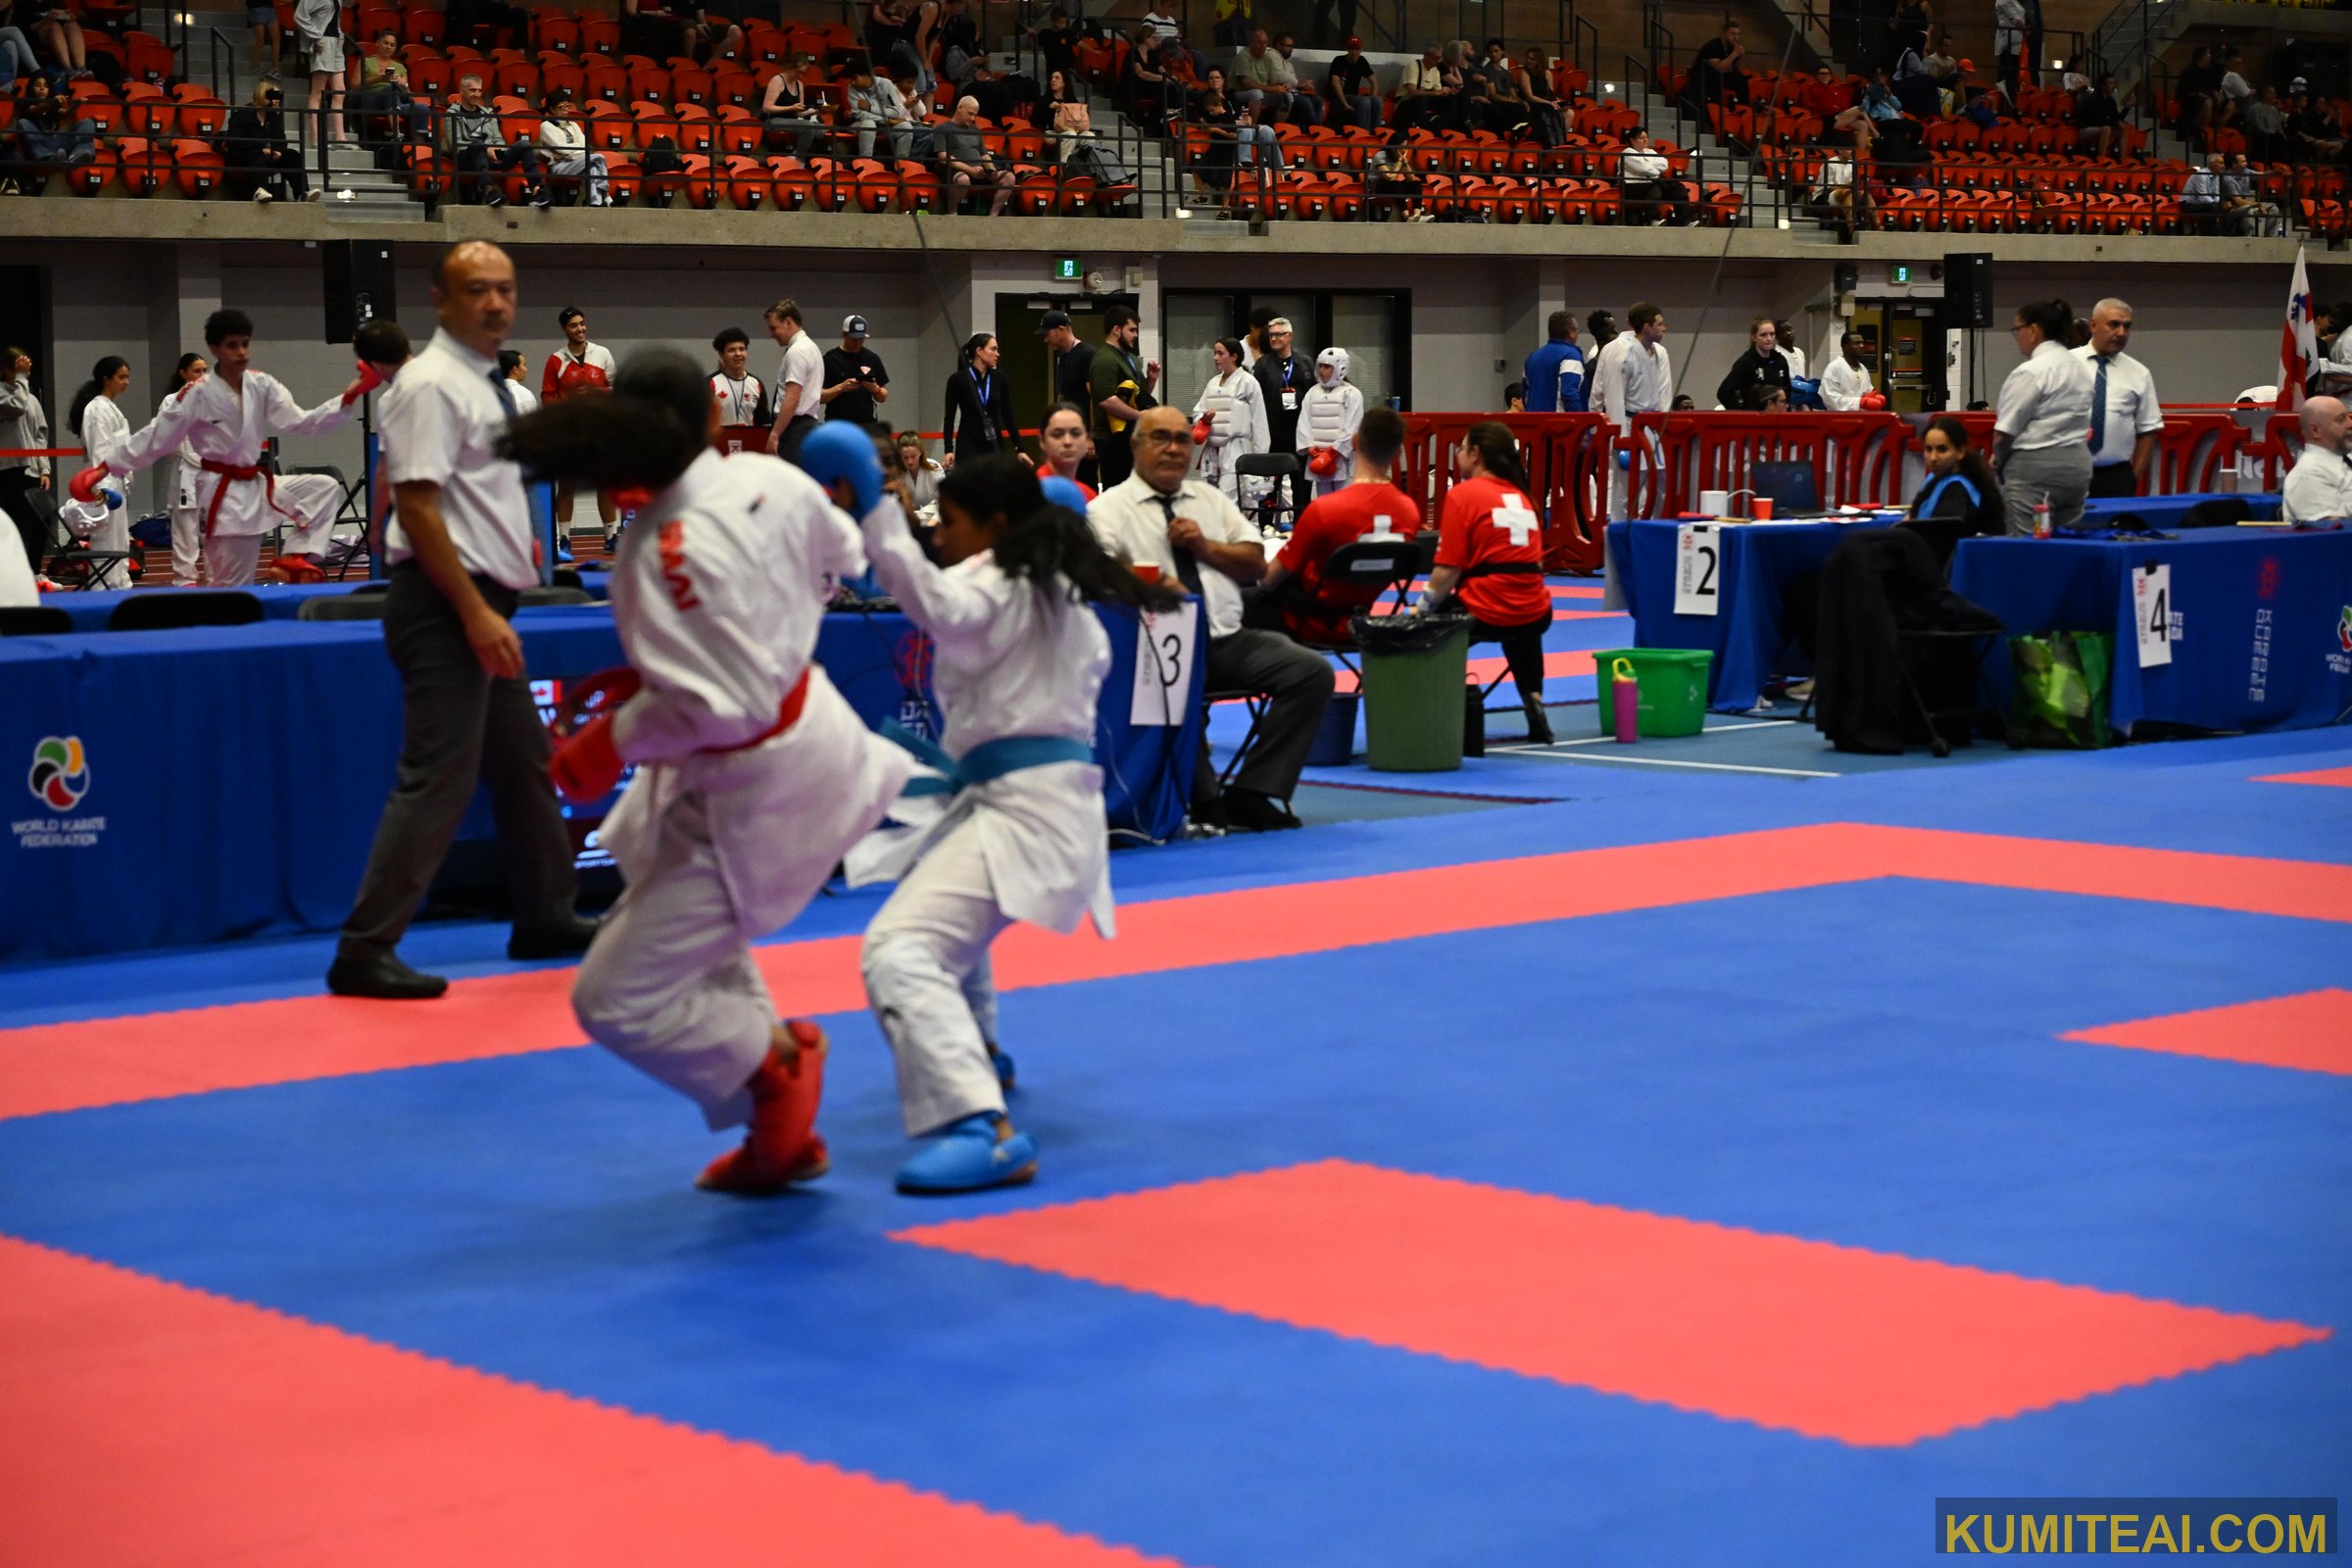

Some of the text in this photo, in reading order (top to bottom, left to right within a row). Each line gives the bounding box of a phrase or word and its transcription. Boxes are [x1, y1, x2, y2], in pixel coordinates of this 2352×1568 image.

[1695, 546, 1716, 595] 2
[2150, 588, 2167, 642] 4
[1161, 634, 1181, 686] 3
[12, 819, 59, 833] WORLD
